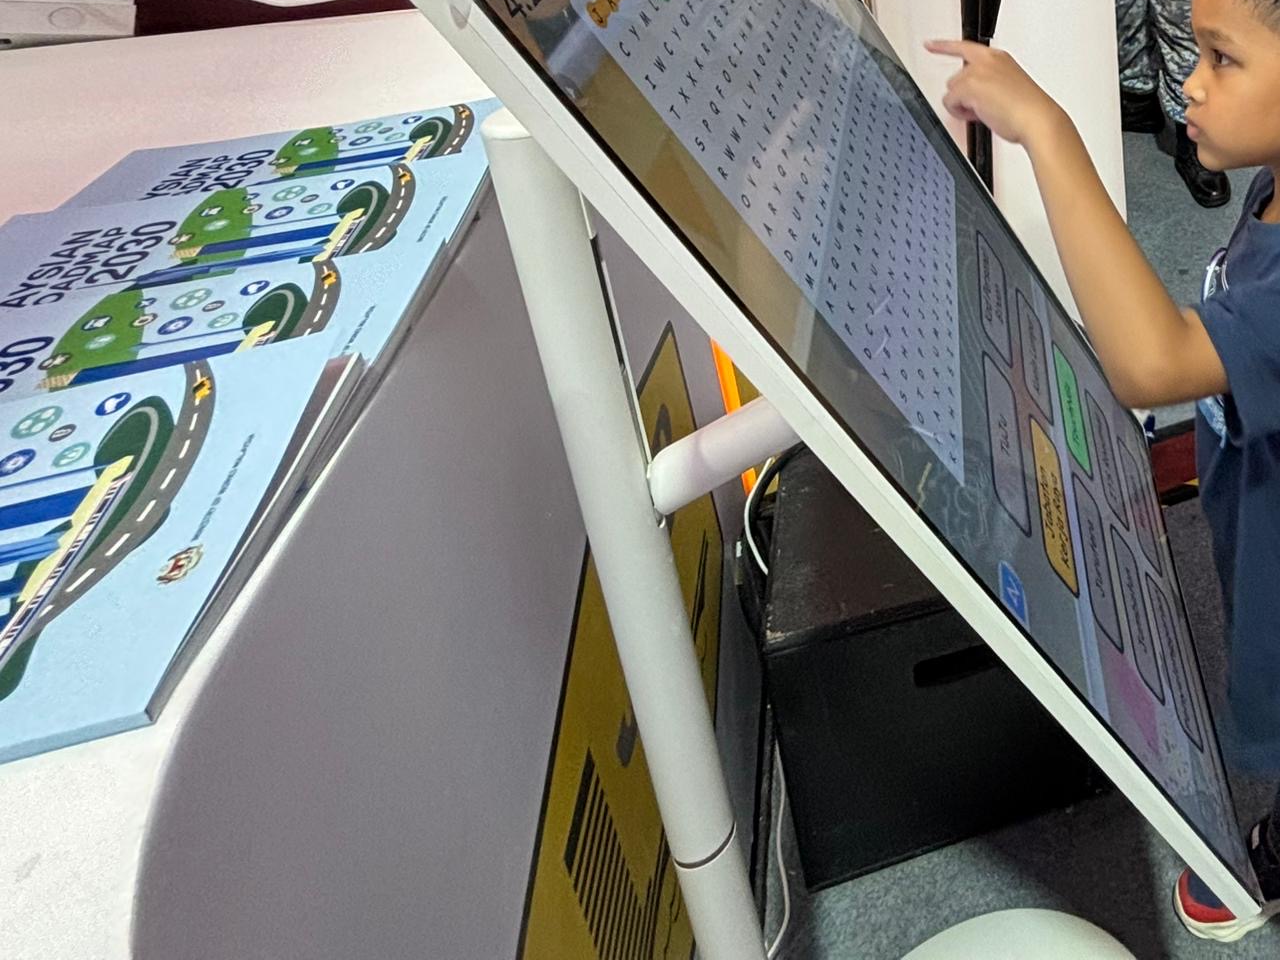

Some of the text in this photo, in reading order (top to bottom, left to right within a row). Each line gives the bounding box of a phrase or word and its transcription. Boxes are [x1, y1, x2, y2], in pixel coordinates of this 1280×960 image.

[200, 149, 276, 192] 2030
[84, 220, 178, 284] 2030
[1041, 466, 1057, 540] Jabatan
[1049, 474, 1073, 570] Kerja Raya
